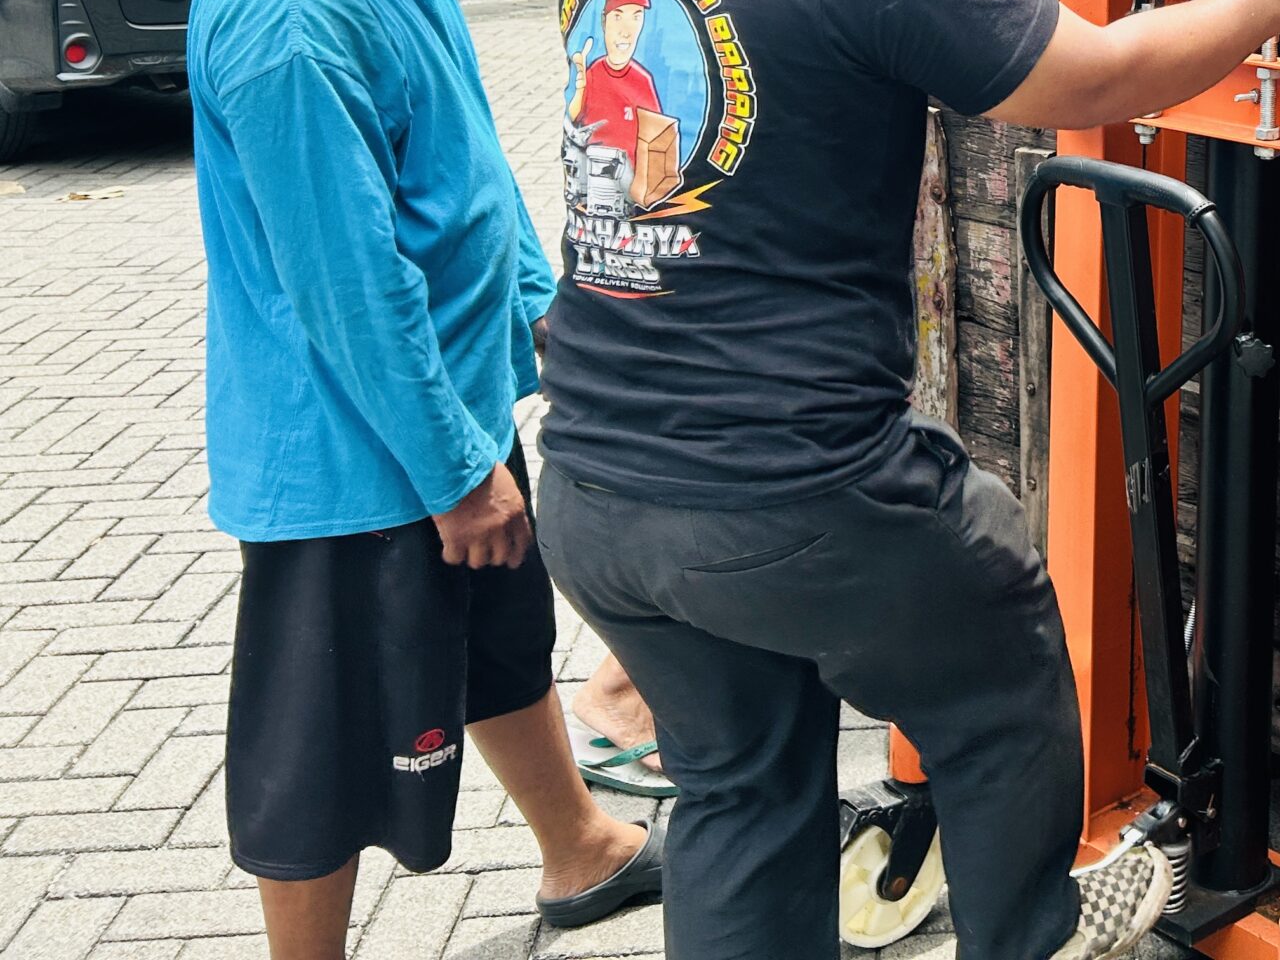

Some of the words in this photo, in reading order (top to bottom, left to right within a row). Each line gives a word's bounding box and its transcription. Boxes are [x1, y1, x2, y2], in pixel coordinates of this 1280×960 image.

[705, 14, 756, 175] BARANG
[594, 277, 629, 288] DELIVERY
[392, 743, 458, 773] EIGER
